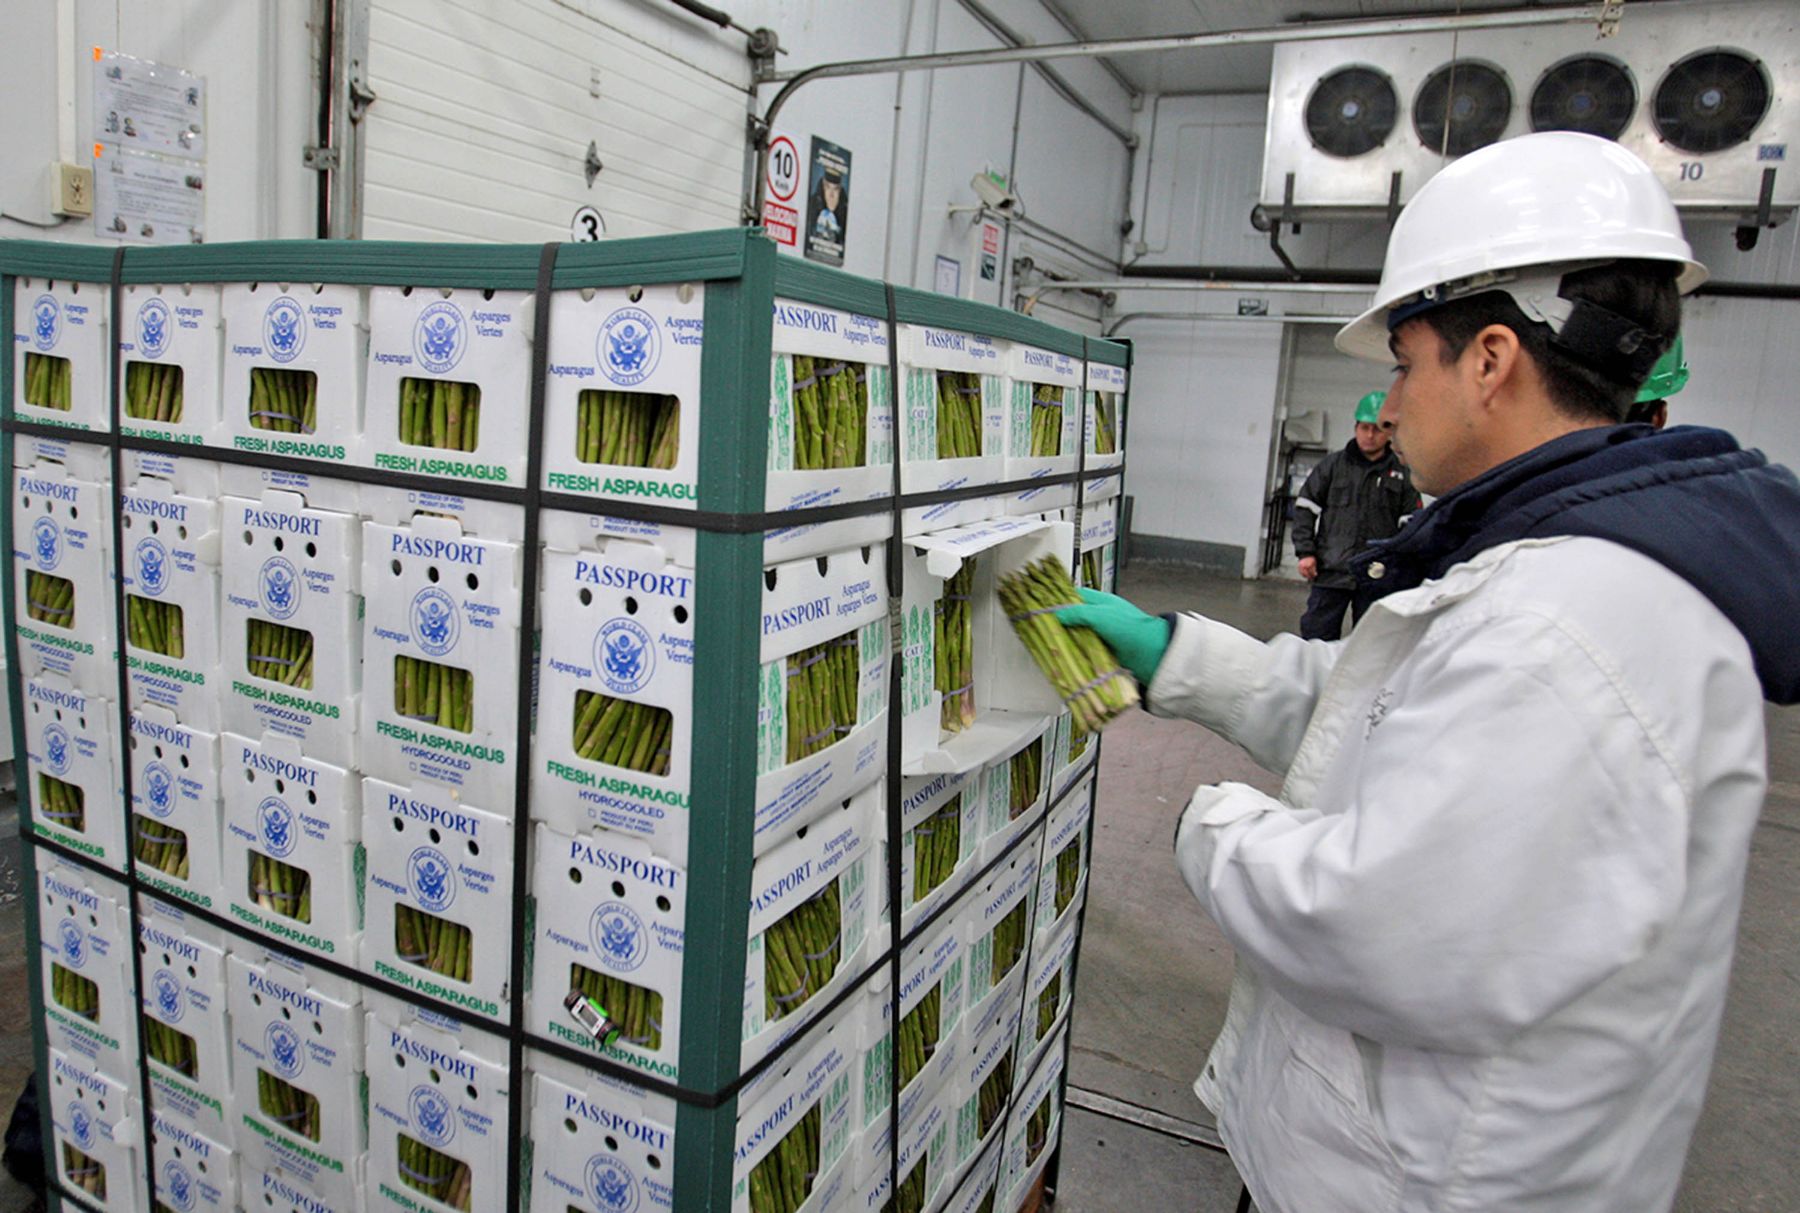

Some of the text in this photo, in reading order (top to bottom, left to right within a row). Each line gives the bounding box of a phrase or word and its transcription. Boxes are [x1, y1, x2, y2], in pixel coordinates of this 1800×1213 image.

[774, 149, 793, 180] 10
[1679, 161, 1704, 181] 10
[309, 304, 343, 317] Asparges
[313, 317, 337, 329] Vertes
[471, 309, 512, 325] Asparges
[667, 316, 703, 332] Asparg
[475, 324, 504, 338] Vertes
[924, 328, 966, 352] PASSPORT
[374, 352, 413, 367] Asparagus
[548, 363, 596, 380] Asparagus
[610, 371, 646, 387] QUALITY
[233, 435, 346, 461] FRESH ASPARAGUS
[375, 453, 508, 482] FRESH ASPARAGUS
[19, 476, 79, 502] PASSPORT
[548, 472, 699, 501] FRESH ASPARAGU
[121, 494, 188, 522] PASSPORT
[244, 507, 323, 537] PASSPORT
[391, 532, 488, 568] PASSPORT
[575, 559, 693, 600] PASSPORT
[841, 579, 872, 599] Asparagus
[461, 599, 502, 618] Asparges
[467, 613, 496, 630] Vertes
[762, 597, 832, 637] PASSPORT
[41, 630, 95, 656] ASPARAGUS
[372, 624, 410, 645] Asparagus
[658, 633, 695, 654] Asparg
[144, 659, 206, 687] ASPARAGUS
[548, 656, 593, 684] Asparagus
[28, 682, 87, 713] PASSPORT
[232, 681, 341, 720] FRESH ASPARAGUS
[129, 714, 193, 749] PASSPORT
[377, 720, 507, 769] FRESH ASPARAGUS
[243, 746, 320, 788] PASSPORT
[401, 744, 472, 771] HYDROCOOLED
[546, 761, 691, 809] FRESH ASPARAGU
[902, 774, 949, 815] PASSPORT
[388, 793, 481, 838] PASSPORT
[578, 789, 665, 820] HYDROCOOLED
[456, 862, 496, 883] Asparges
[568, 840, 682, 890] PASSPORT
[45, 874, 99, 912] PASSPORT
[230, 903, 336, 954] FRESH ASPARAGUS
[544, 926, 590, 955] Asparagus
[655, 937, 684, 958] Verte
[248, 971, 323, 1018] PASSPORT
[374, 960, 499, 1017] FRESH ASPARAGUS
[548, 1019, 596, 1056] FRESH
[390, 1030, 479, 1082] PASSPORT
[565, 1092, 670, 1151] PASSPORT
